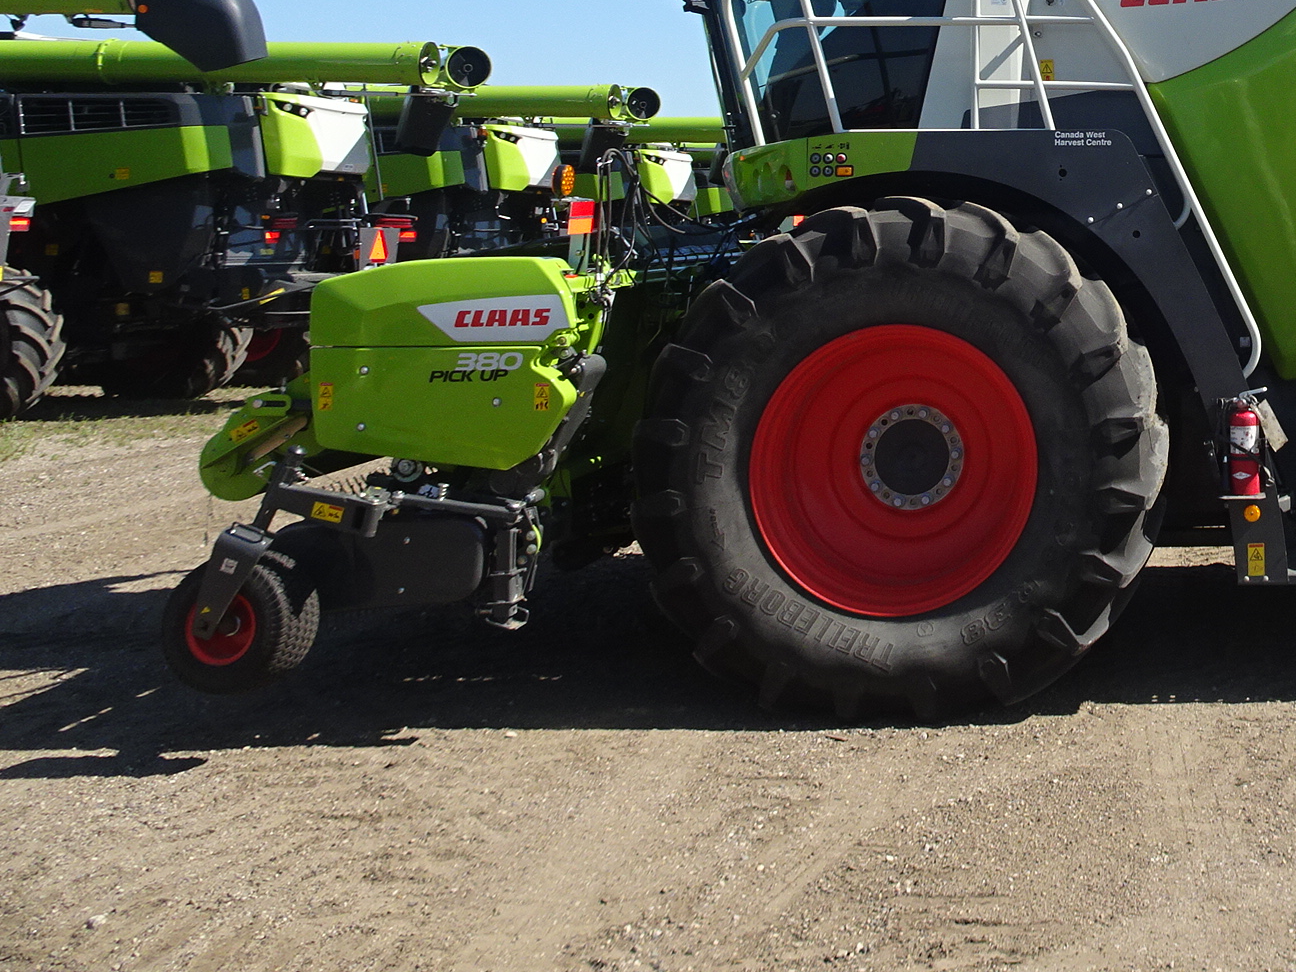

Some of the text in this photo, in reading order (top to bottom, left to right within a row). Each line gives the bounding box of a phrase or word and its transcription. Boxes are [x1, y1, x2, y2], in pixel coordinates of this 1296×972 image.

[1054, 138, 1112, 146] Harvest Centre
[454, 308, 551, 327] CLAAS
[455, 352, 524, 371] 380
[429, 369, 509, 383] PICK UP
[722, 567, 895, 672] TRELLEBORG
